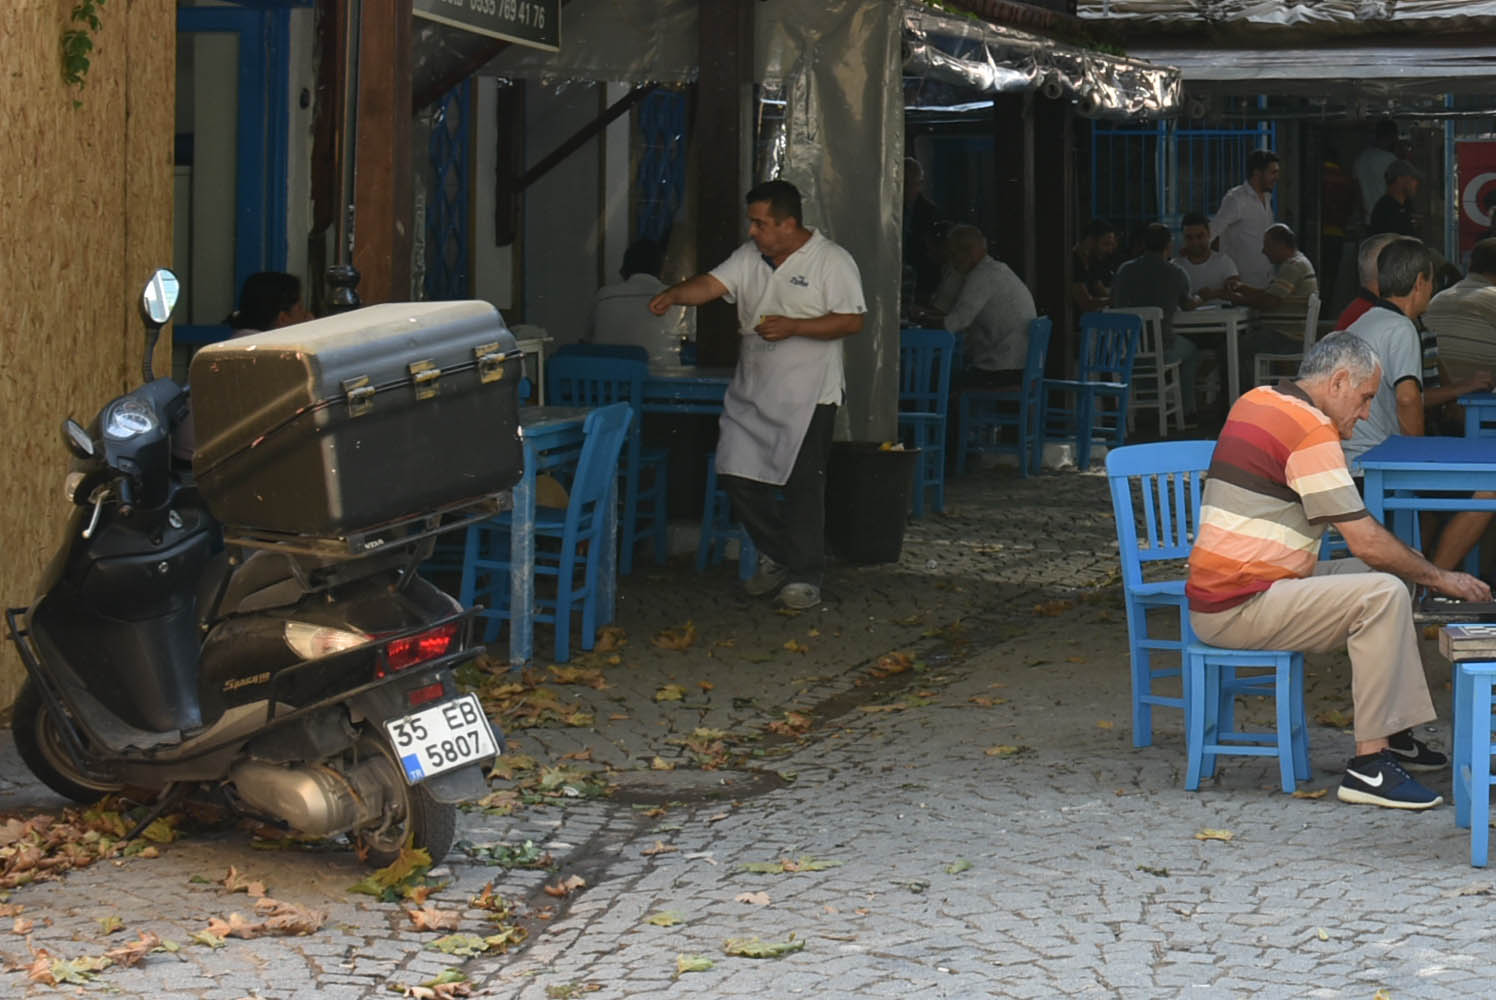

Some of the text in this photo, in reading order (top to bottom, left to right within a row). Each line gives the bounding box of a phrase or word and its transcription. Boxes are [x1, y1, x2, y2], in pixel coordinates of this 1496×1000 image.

[518, 1, 531, 25] 41
[532, 4, 546, 30] 76
[393, 701, 478, 747] 35 EB
[425, 730, 480, 767] 5807
